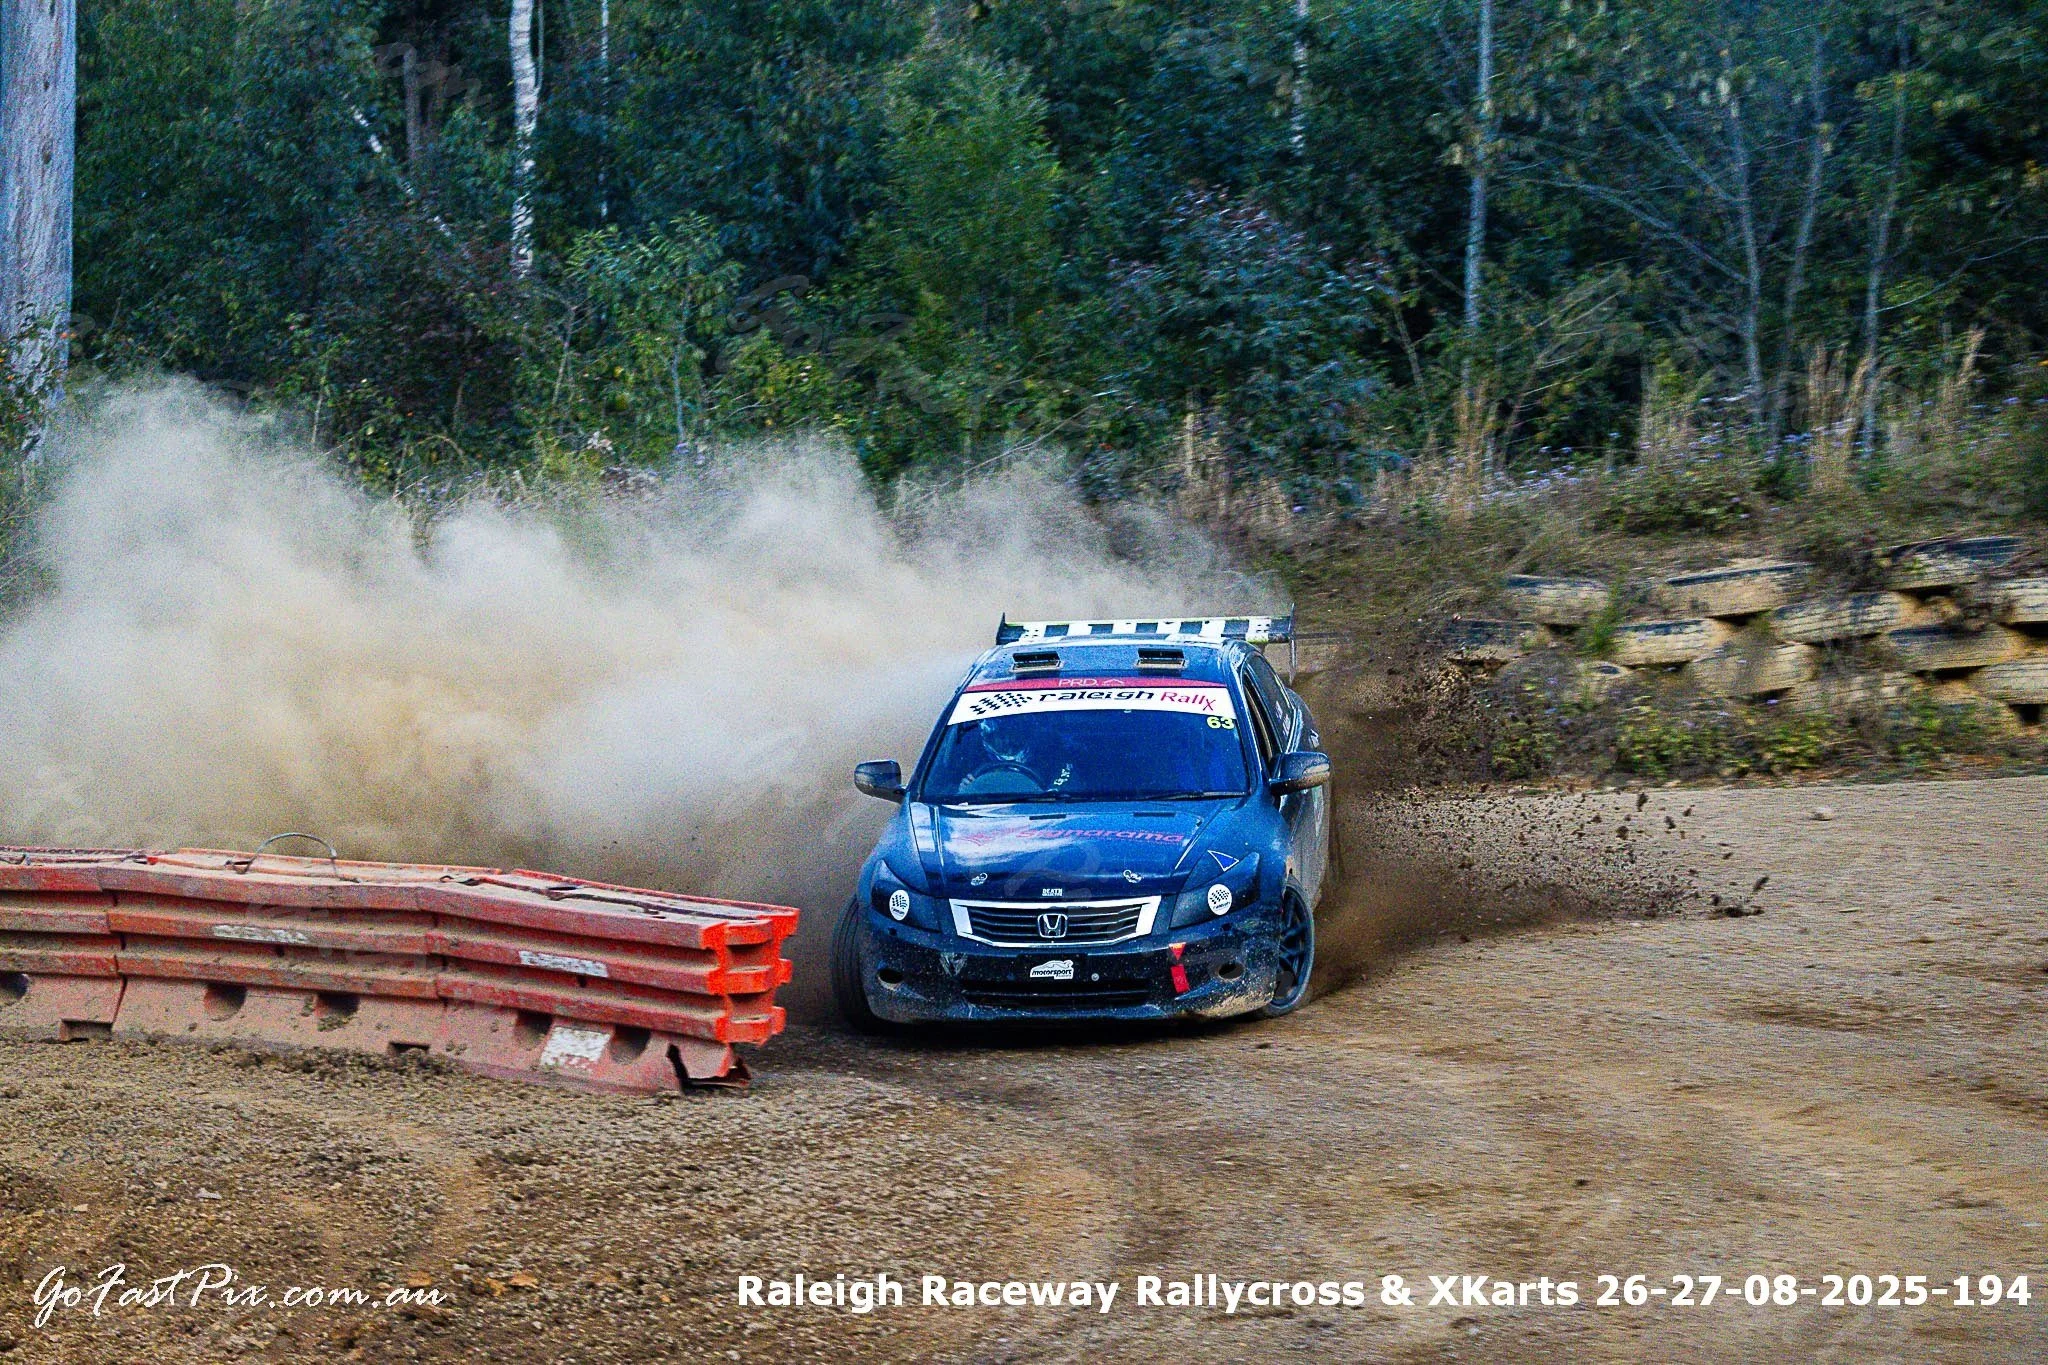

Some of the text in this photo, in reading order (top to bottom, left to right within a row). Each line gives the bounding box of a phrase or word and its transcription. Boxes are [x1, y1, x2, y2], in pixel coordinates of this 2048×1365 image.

[1039, 690, 1155, 702] raleigh
[1206, 716, 1235, 730] 63
[1031, 969, 1072, 978] motorsport
